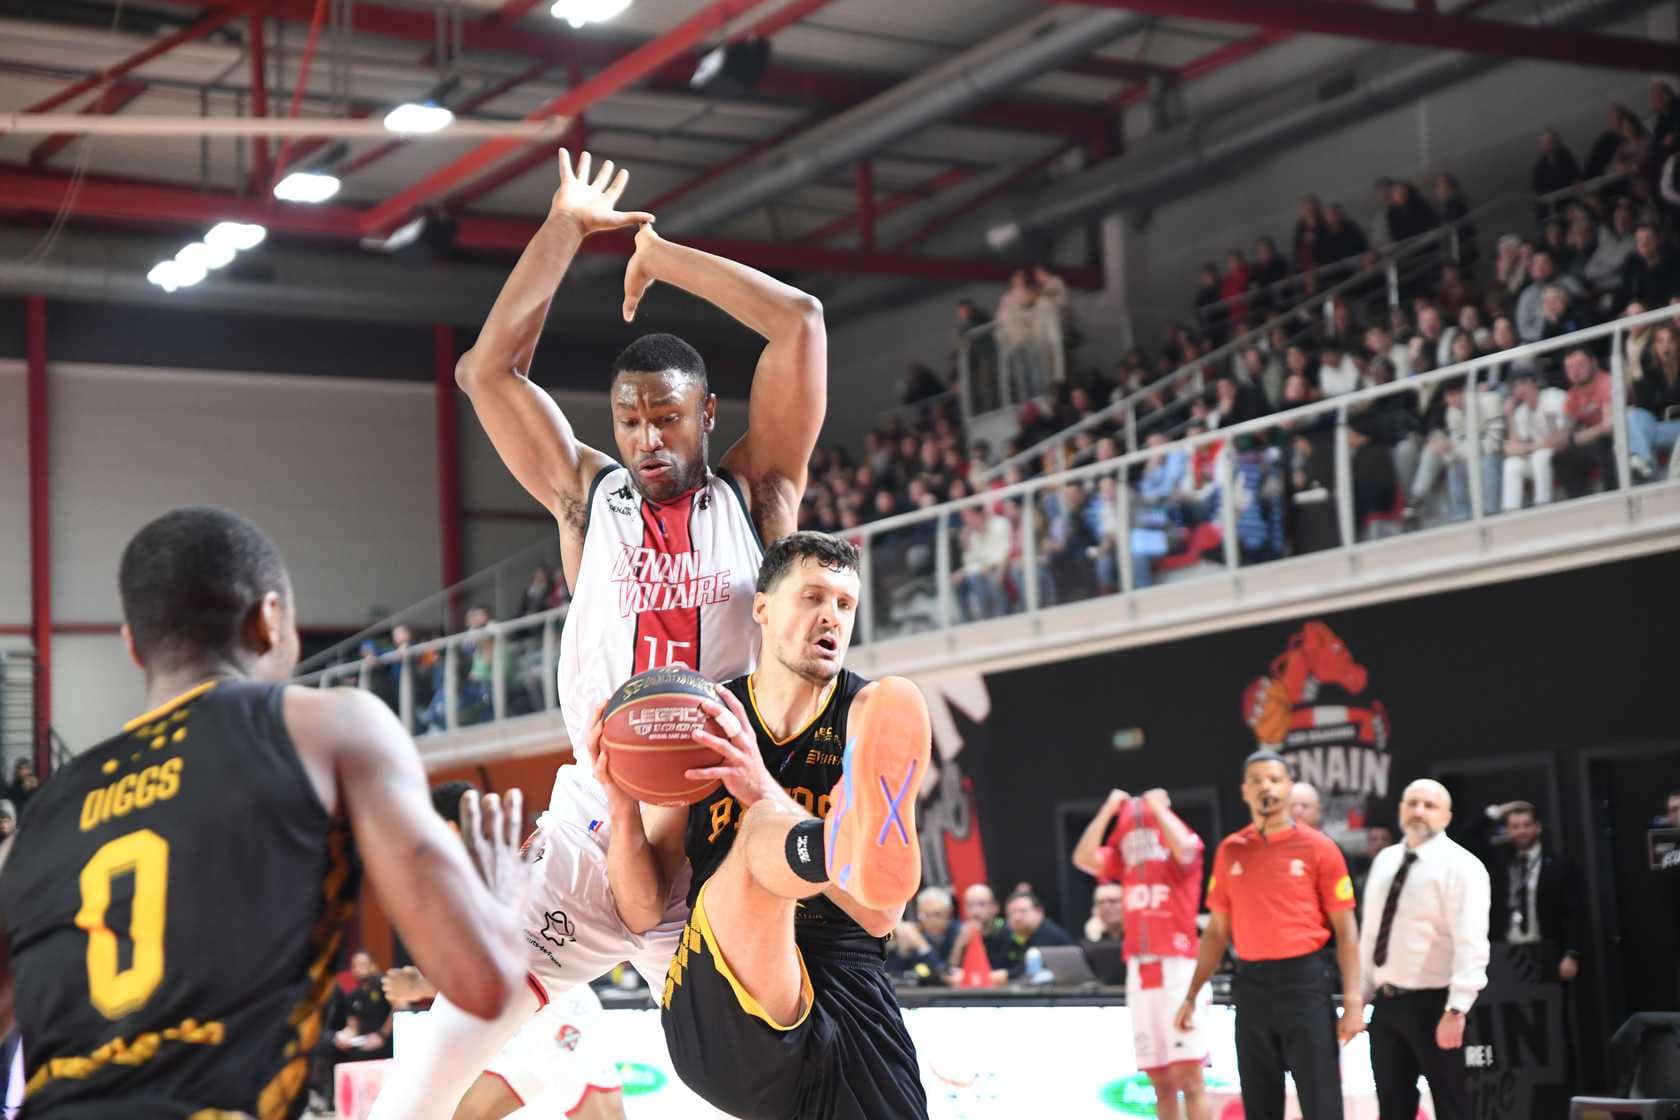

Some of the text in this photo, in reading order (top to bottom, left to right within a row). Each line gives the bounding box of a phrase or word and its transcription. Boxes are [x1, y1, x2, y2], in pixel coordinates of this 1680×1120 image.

[610, 541, 701, 583] DENAIN
[613, 570, 731, 618] VOLTAIRE
[79, 757, 184, 831] DIGGS
[74, 829, 170, 1019] 0
